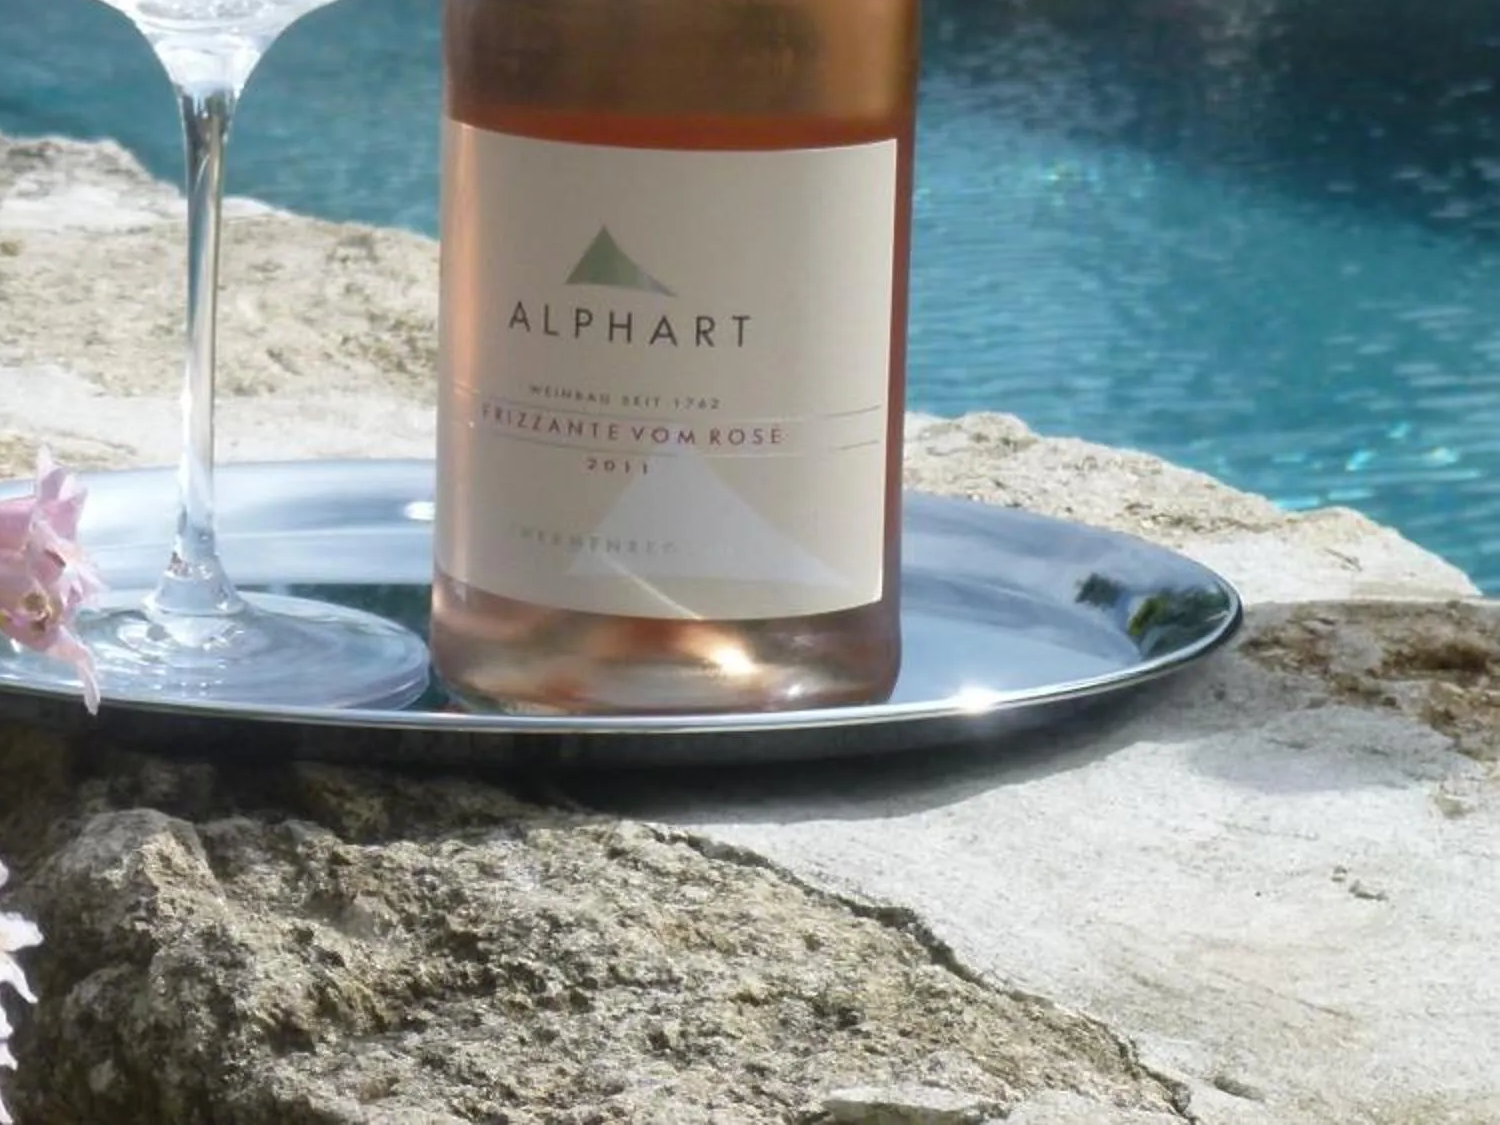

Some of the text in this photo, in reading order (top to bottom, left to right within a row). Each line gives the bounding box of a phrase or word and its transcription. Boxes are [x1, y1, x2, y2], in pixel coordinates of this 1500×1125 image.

[508, 300, 751, 348] ALPHART
[528, 383, 611, 406] WEINBAU
[622, 393, 660, 409] SEIT
[481, 402, 620, 441] FRIZZANTE
[630, 425, 697, 446] VOM
[586, 457, 649, 475] 2011
